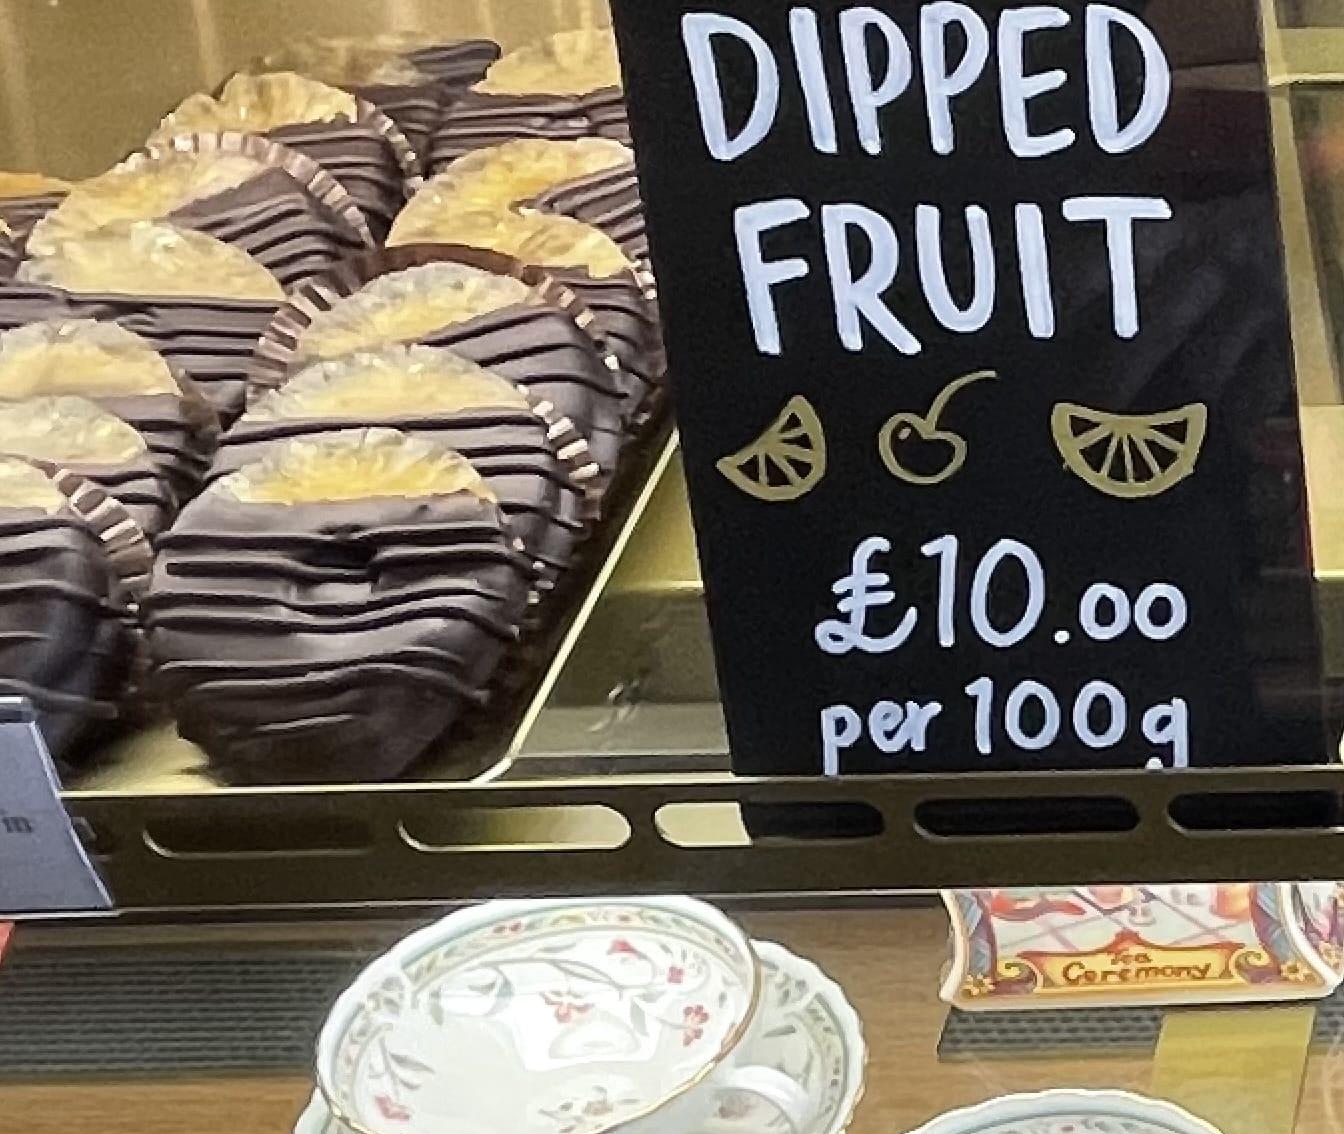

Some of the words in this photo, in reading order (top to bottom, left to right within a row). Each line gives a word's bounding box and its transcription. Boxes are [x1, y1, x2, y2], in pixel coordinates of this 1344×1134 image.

[681, 2, 1172, 161] DIPPED
[733, 197, 1172, 355] FRUIT
[814, 534, 1188, 655] £10.00
[821, 699, 942, 778] per
[1063, 960, 1212, 985] Ceremony
